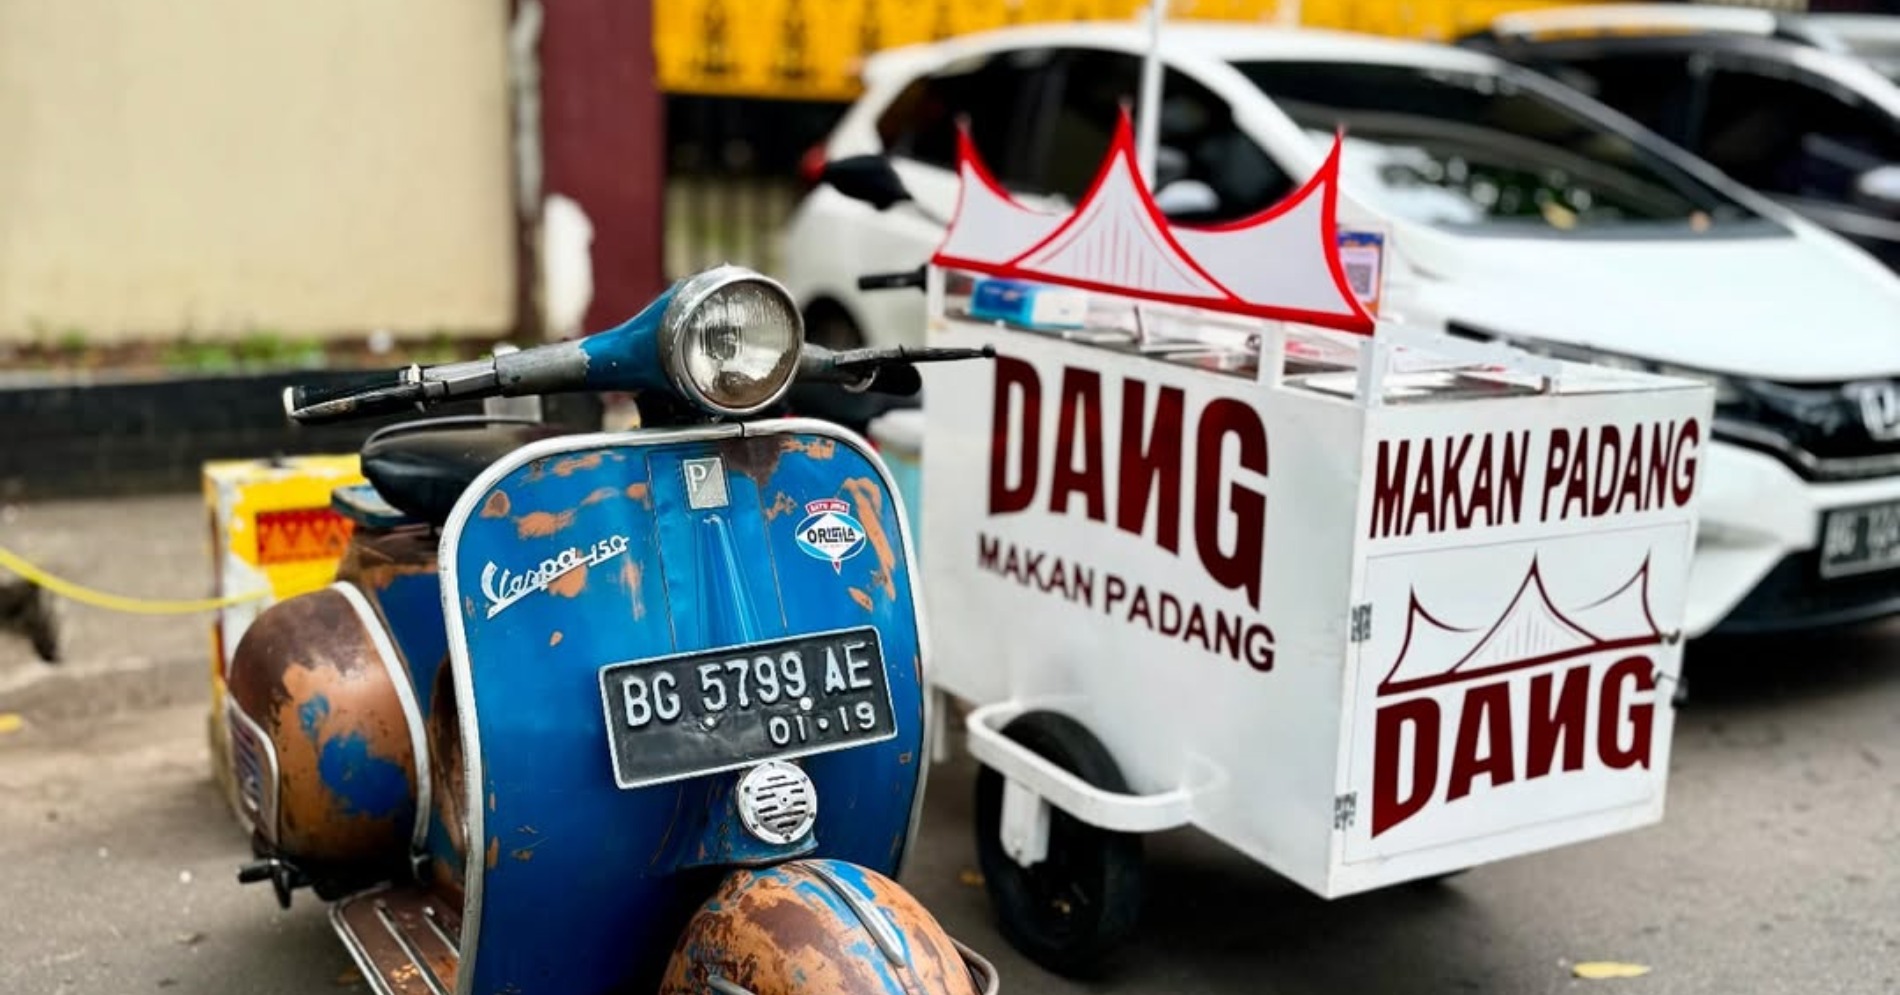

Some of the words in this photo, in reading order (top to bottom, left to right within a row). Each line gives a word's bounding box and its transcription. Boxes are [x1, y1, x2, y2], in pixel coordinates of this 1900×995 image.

[1369, 431, 1531, 538] MAKAN
[1541, 418, 1700, 523] PADANG
[481, 547, 579, 619] Vespa
[588, 534, 631, 568] 150
[978, 536, 1096, 607] MAKAN
[1104, 574, 1276, 673] PADANG
[622, 674, 681, 727] BG
[697, 651, 808, 711] 5799
[824, 641, 874, 693] AE
